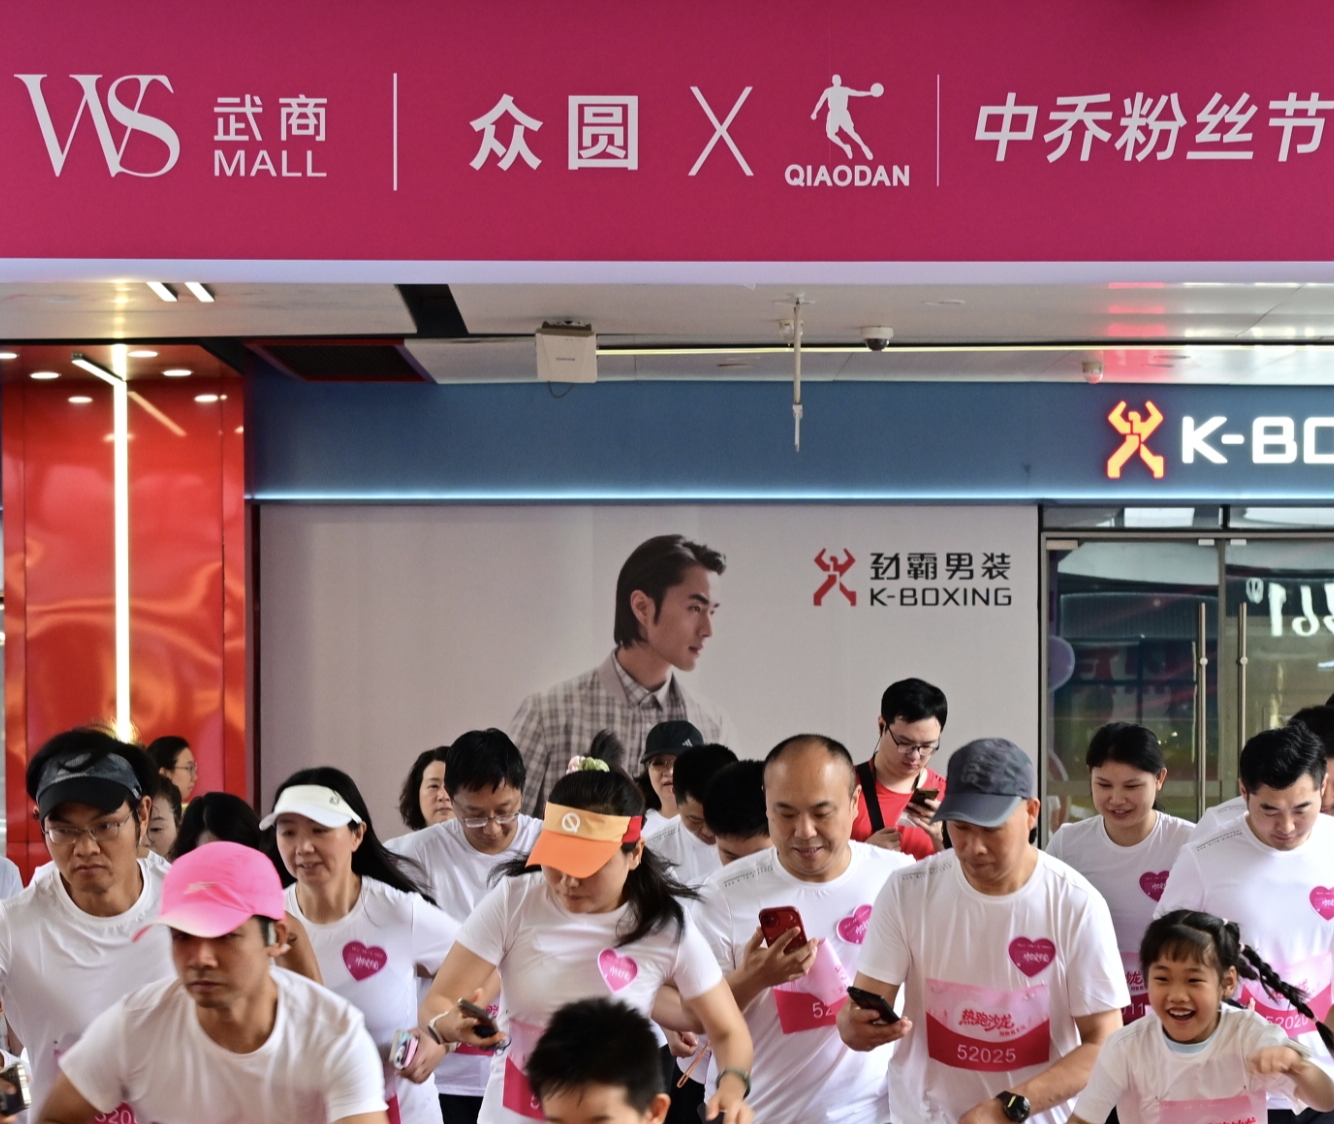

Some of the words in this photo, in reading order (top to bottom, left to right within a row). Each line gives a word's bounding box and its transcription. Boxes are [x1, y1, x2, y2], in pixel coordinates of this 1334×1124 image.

[13, 74, 181, 178] WS
[213, 93, 328, 142] 武商
[468, 92, 639, 172] 众圆
[213, 149, 328, 178] MALL
[784, 164, 911, 188] QIAODAN
[869, 551, 1012, 581] 劲霸男装
[869, 586, 1013, 607] K-BOXING
[959, 1009, 1015, 1032] 热跑沙龙
[956, 1044, 1017, 1064] 52025
